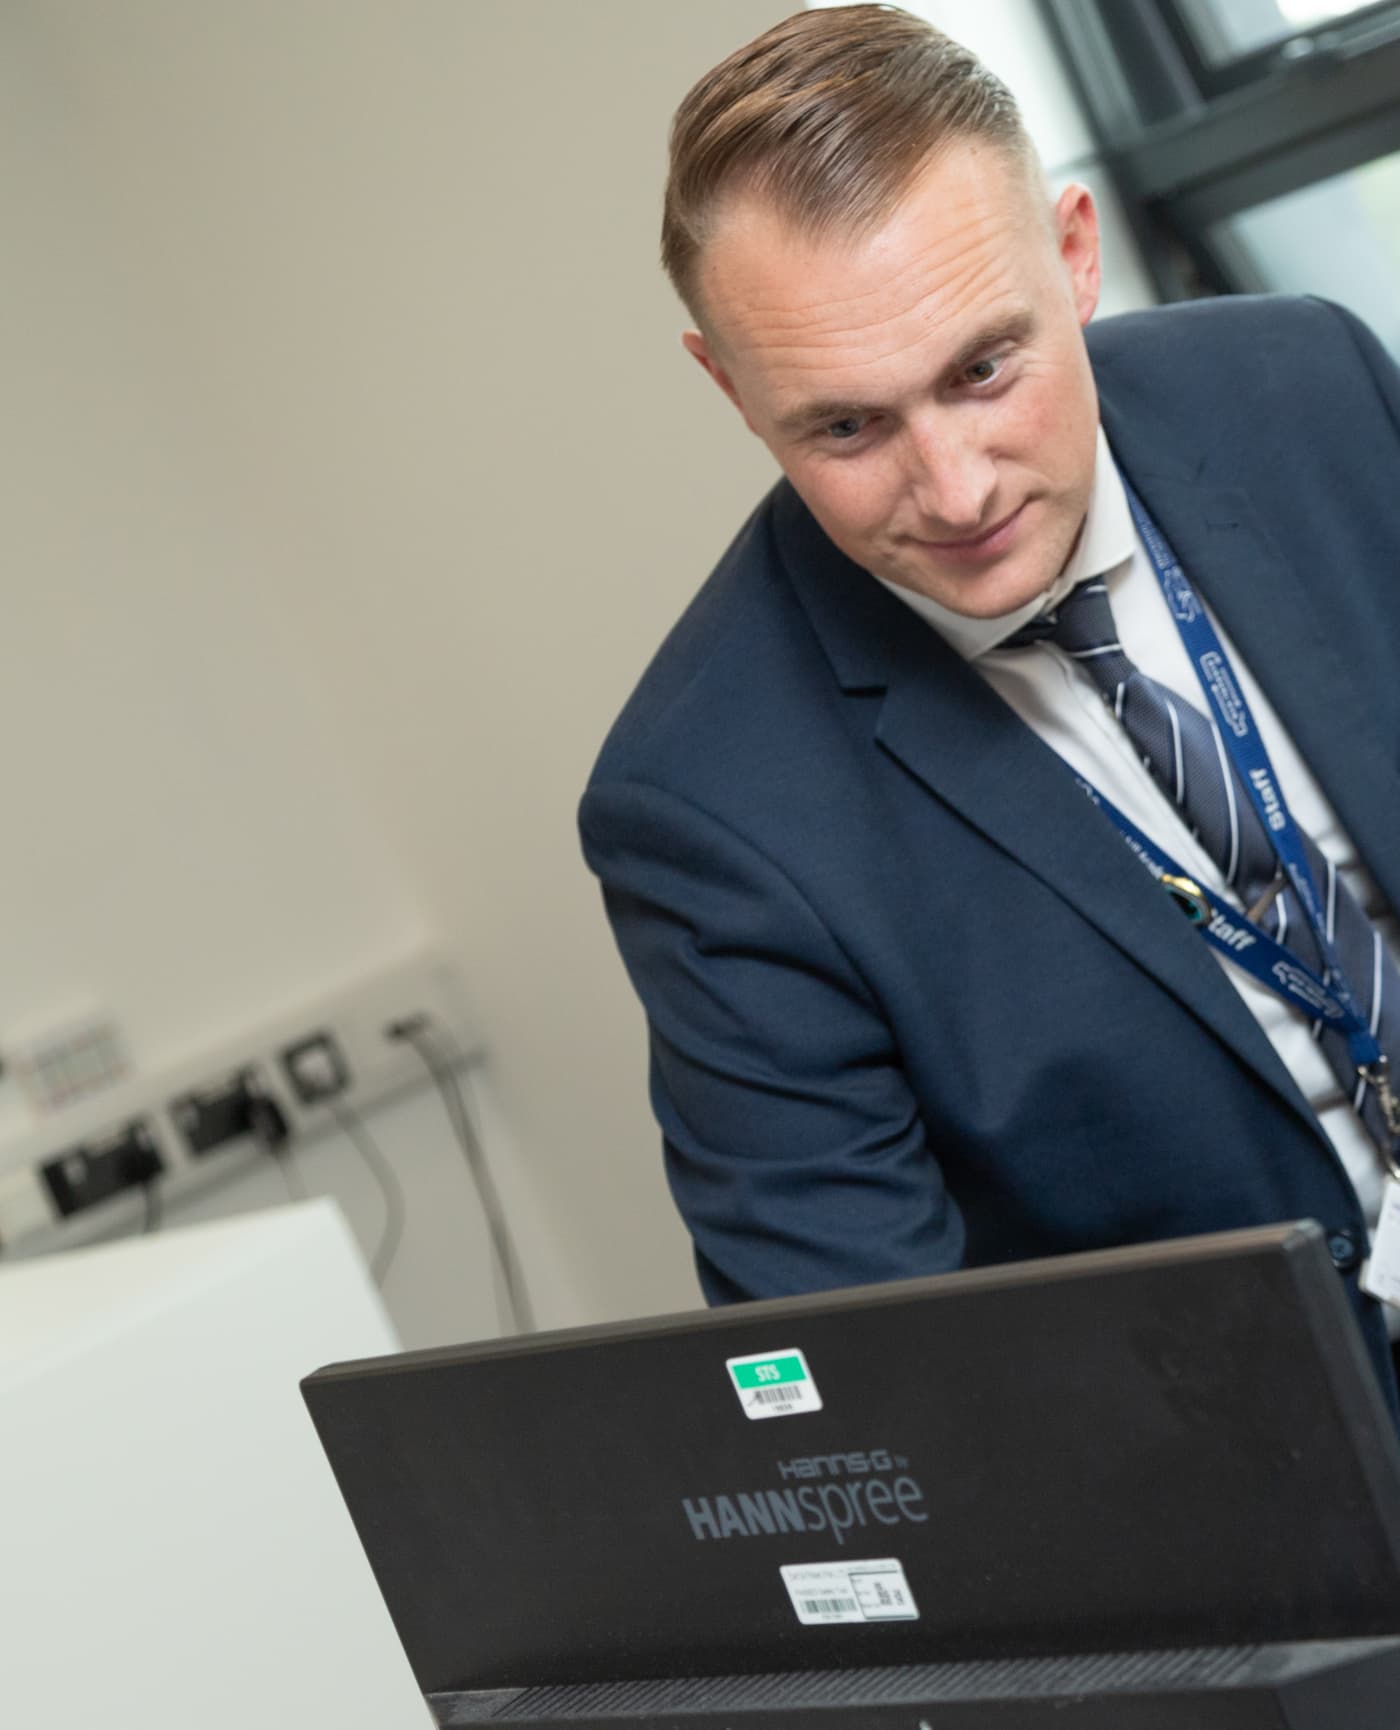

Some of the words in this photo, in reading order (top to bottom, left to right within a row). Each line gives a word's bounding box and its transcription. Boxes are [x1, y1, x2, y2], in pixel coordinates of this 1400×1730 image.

[1250, 769, 1286, 831] Staff
[1207, 910, 1257, 951] taff
[755, 1364, 780, 1382] STS
[681, 1476, 929, 1545] HANNspree
